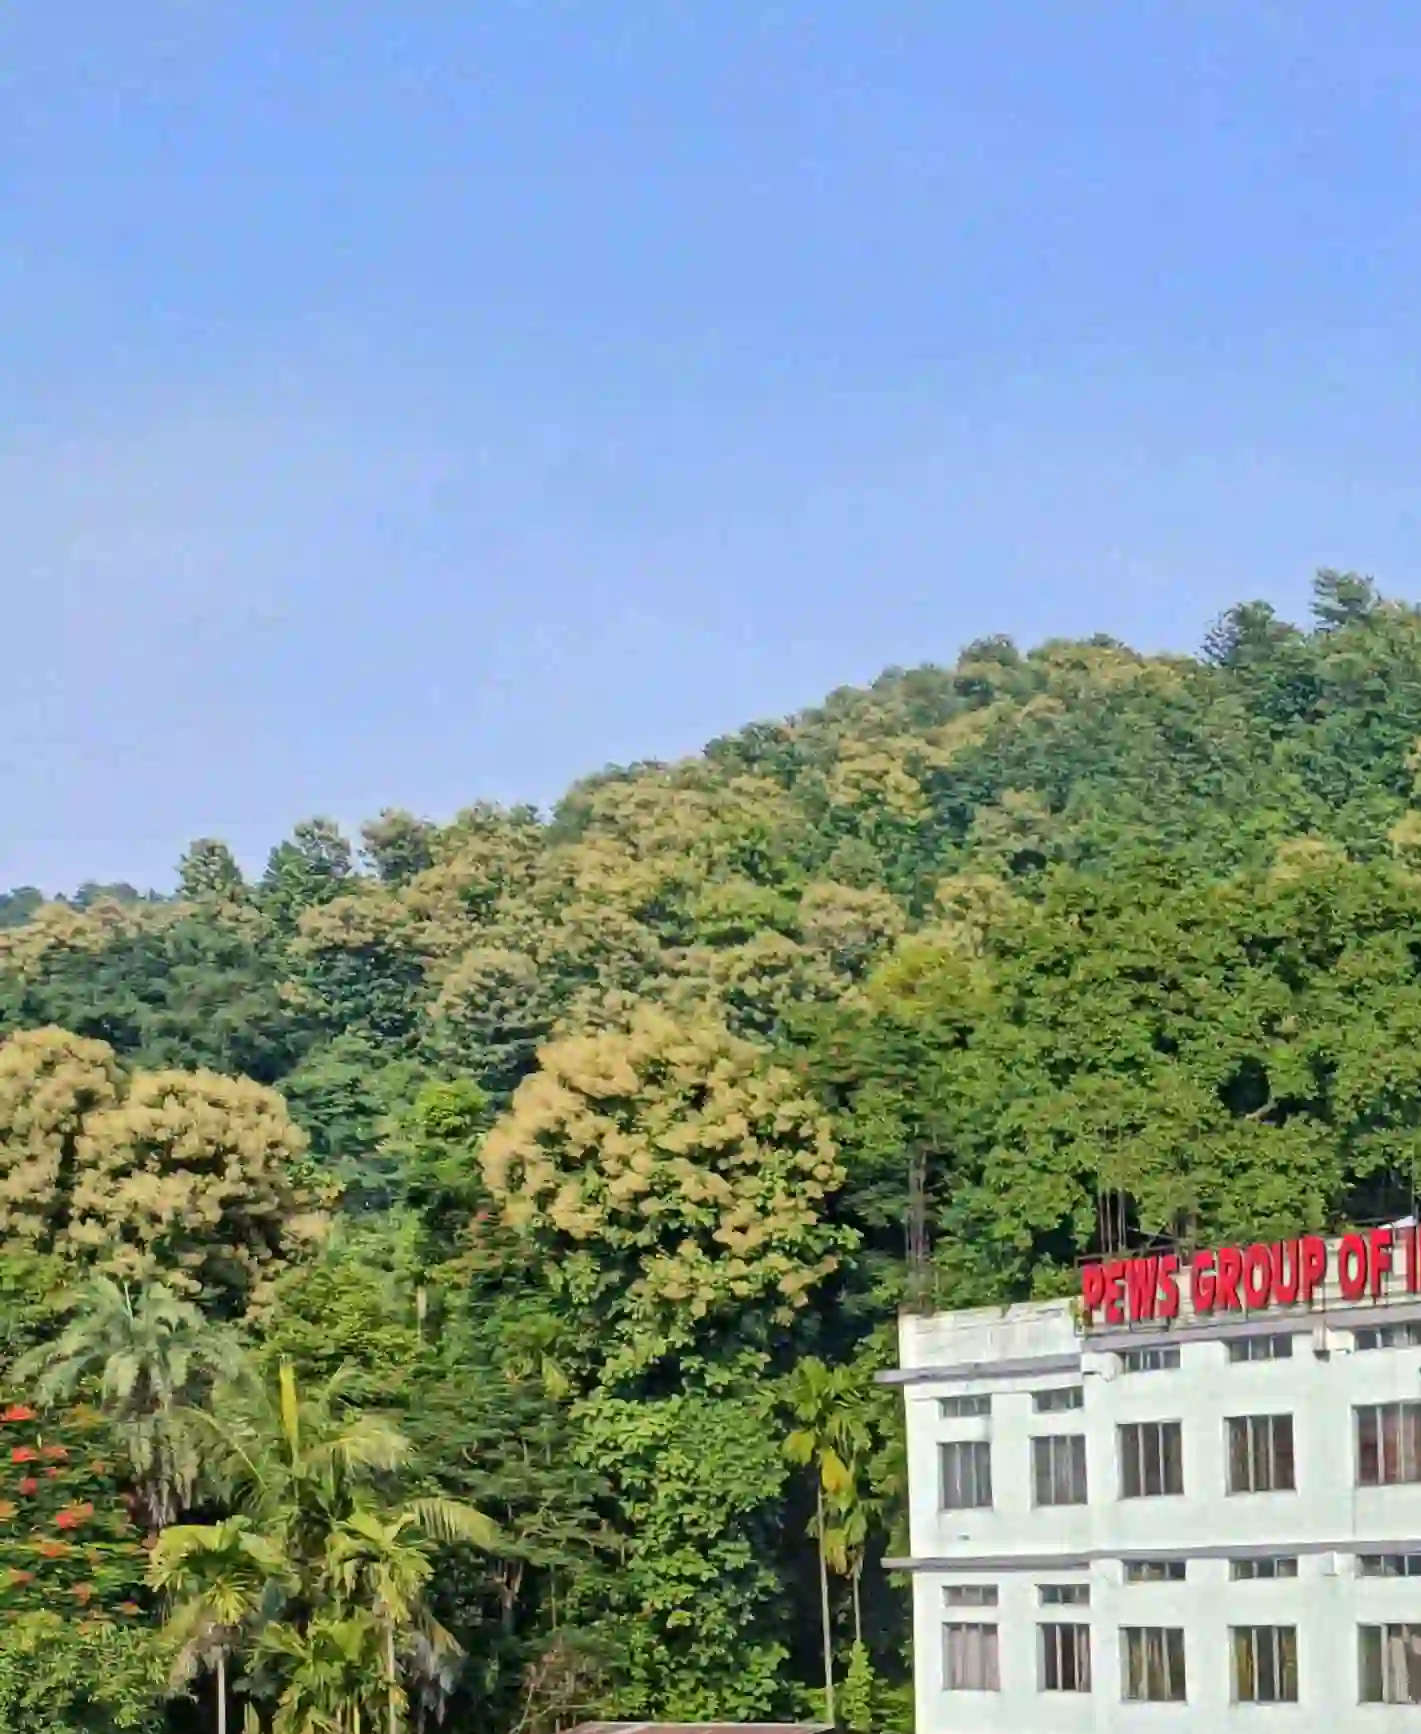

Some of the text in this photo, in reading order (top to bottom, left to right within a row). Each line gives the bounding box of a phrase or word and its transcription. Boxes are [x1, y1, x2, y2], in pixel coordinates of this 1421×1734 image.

[1083, 1254, 1181, 1324] PEWS
[1190, 1235, 1327, 1314] GROUP
[1339, 1227, 1393, 1301] OF
